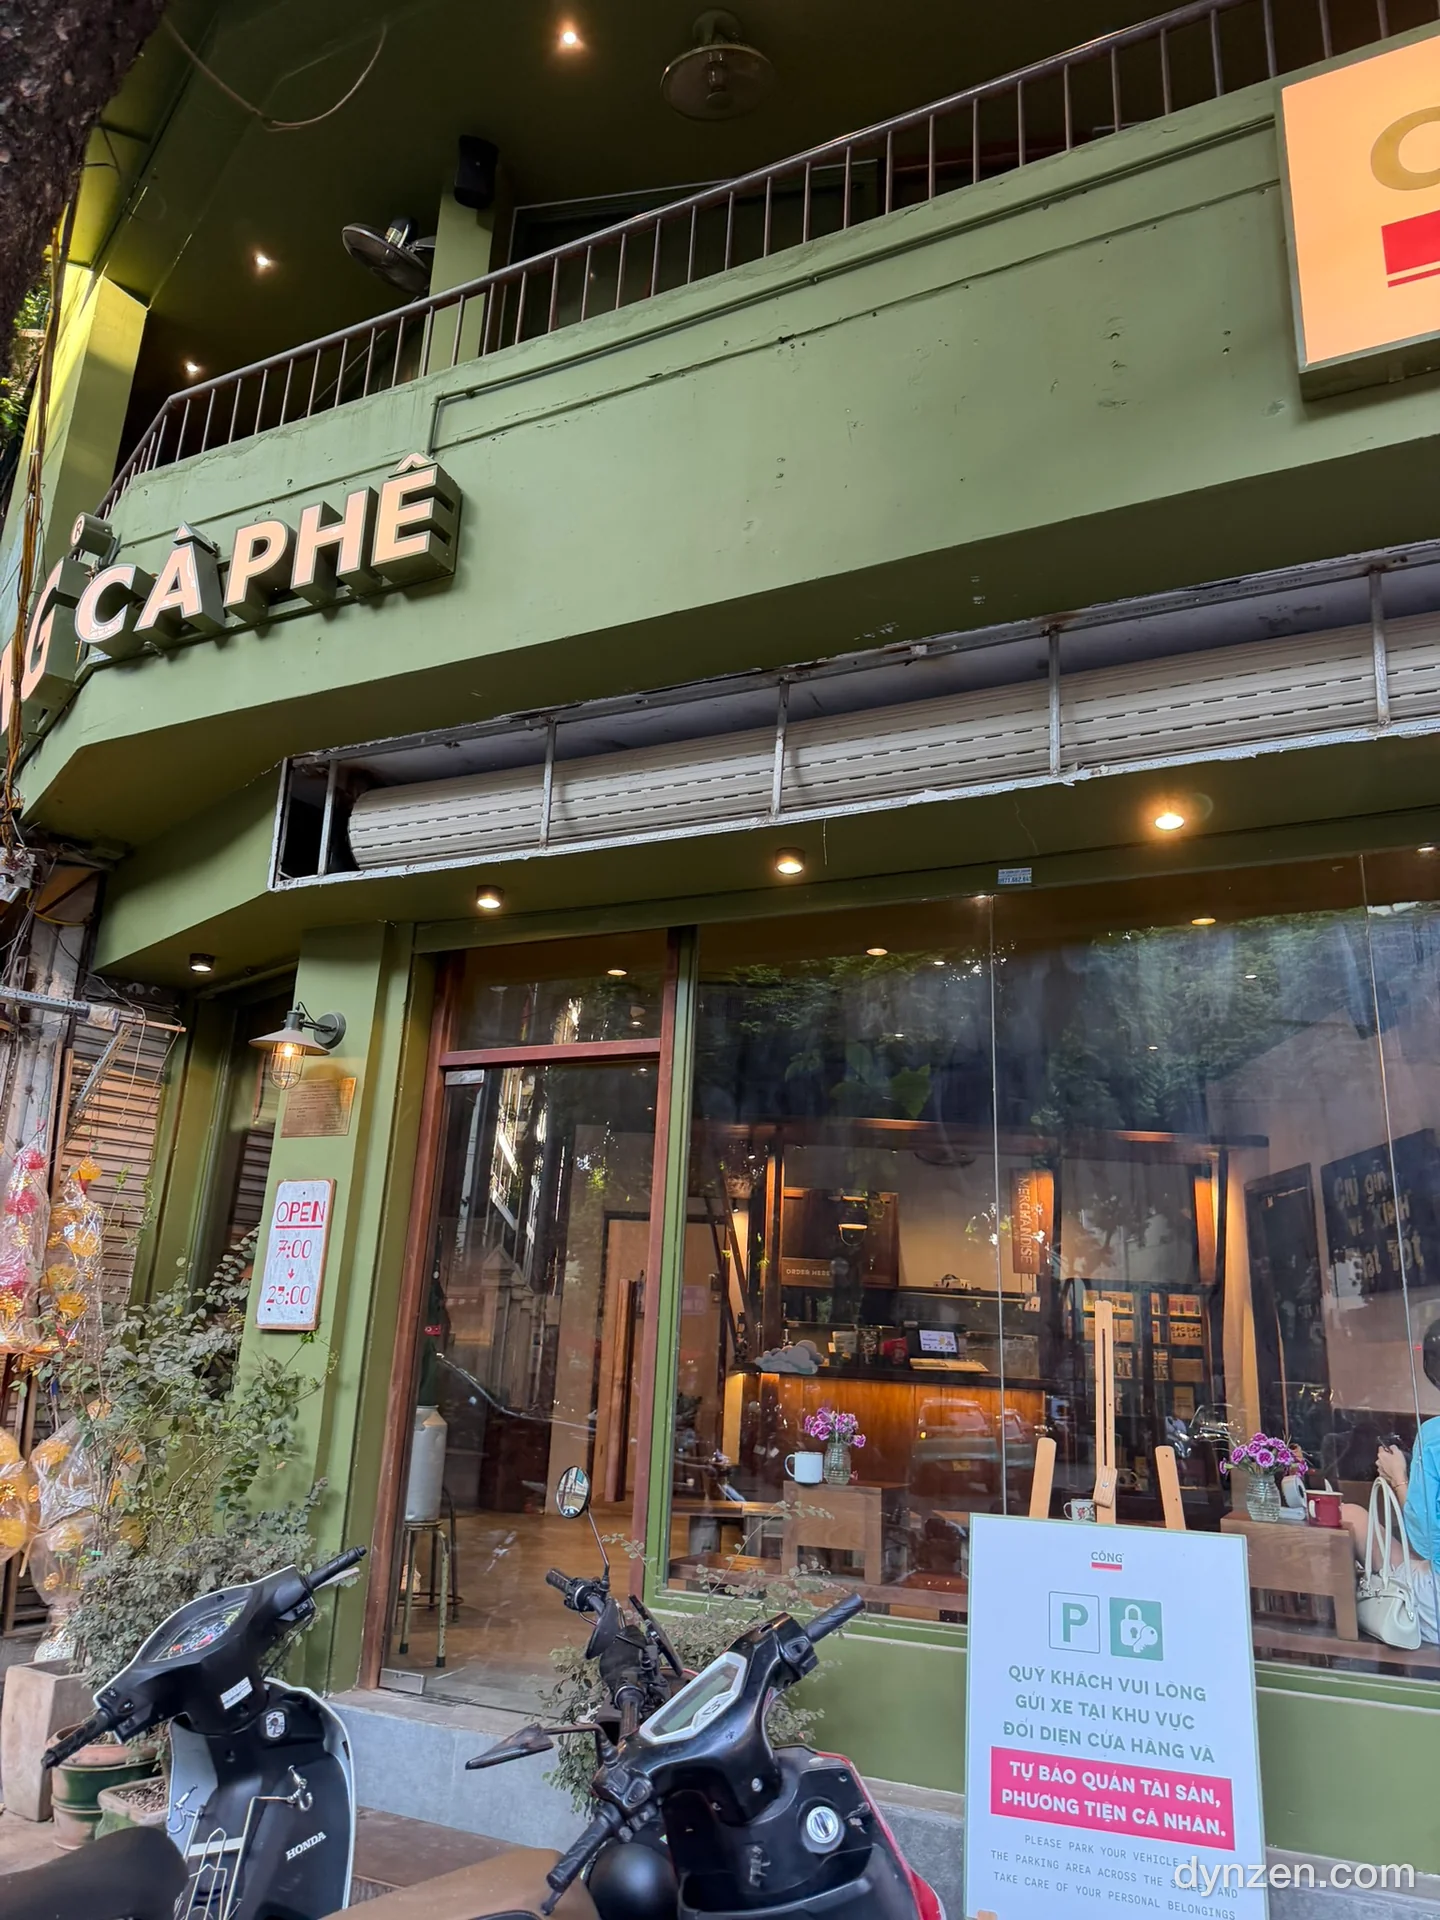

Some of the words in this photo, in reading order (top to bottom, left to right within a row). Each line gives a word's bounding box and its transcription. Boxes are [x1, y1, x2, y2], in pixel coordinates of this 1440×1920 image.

[223, 452, 439, 607] PHÊ
[276, 1200, 326, 1224] OPEN
[1018, 1177, 1033, 1265] MERCHANDISE
[275, 1239, 313, 1260] 7:00
[786, 1268, 811, 1276] ORDER
[266, 1285, 312, 1306] 23:00
[1062, 1602, 1089, 1643] P
[1050, 1669, 1113, 1691] KHÁCH
[1118, 1677, 1149, 1695] VUI
[1156, 1680, 1206, 1702] LÒNG
[1051, 1698, 1073, 1714] XE
[1078, 1702, 1106, 1721] TẠI
[1112, 1706, 1150, 1724] KHU
[1155, 1711, 1195, 1731] VỰC
[1003, 1717, 1034, 1739] ĐỐI
[1040, 1726, 1081, 1746] DIỆN
[1131, 1737, 1185, 1759] HÀNG
[1190, 1744, 1215, 1763] VÀ
[1009, 1761, 1034, 1782] TỰ
[1039, 1763, 1076, 1785] BẢO
[1082, 1770, 1136, 1794] QUẢN
[1001, 1788, 1079, 1815] PHƯƠNG
[1084, 1800, 1127, 1823] TIỆN
[1164, 1811, 1227, 1837] NHÂN.
[286, 1831, 327, 1861] HONDA
[1024, 1834, 1062, 1849] PLEASE
[1069, 1841, 1094, 1854] PARK
[1100, 1845, 1127, 1860] YOUR
[1133, 1851, 1179, 1868] VEHICLE
[990, 1850, 1009, 1861] THE
[1015, 1854, 1059, 1870] PARKING
[1065, 1862, 1092, 1875] AREA
[1097, 1867, 1137, 1883] ACROSS
[1144, 1874, 1163, 1887] THE
[1170, 1879, 1208, 1893] SEE
[1217, 1887, 1238, 1899] AND
[993, 1871, 1018, 1885] TAKE
[1024, 1876, 1049, 1890] CARE
[1056, 1882, 1069, 1893] OF
[1075, 1885, 1101, 1898] YOUR
[1108, 1891, 1160, 1909] PERSONAL
[1168, 1901, 1236, 1920] BELONGINGS
